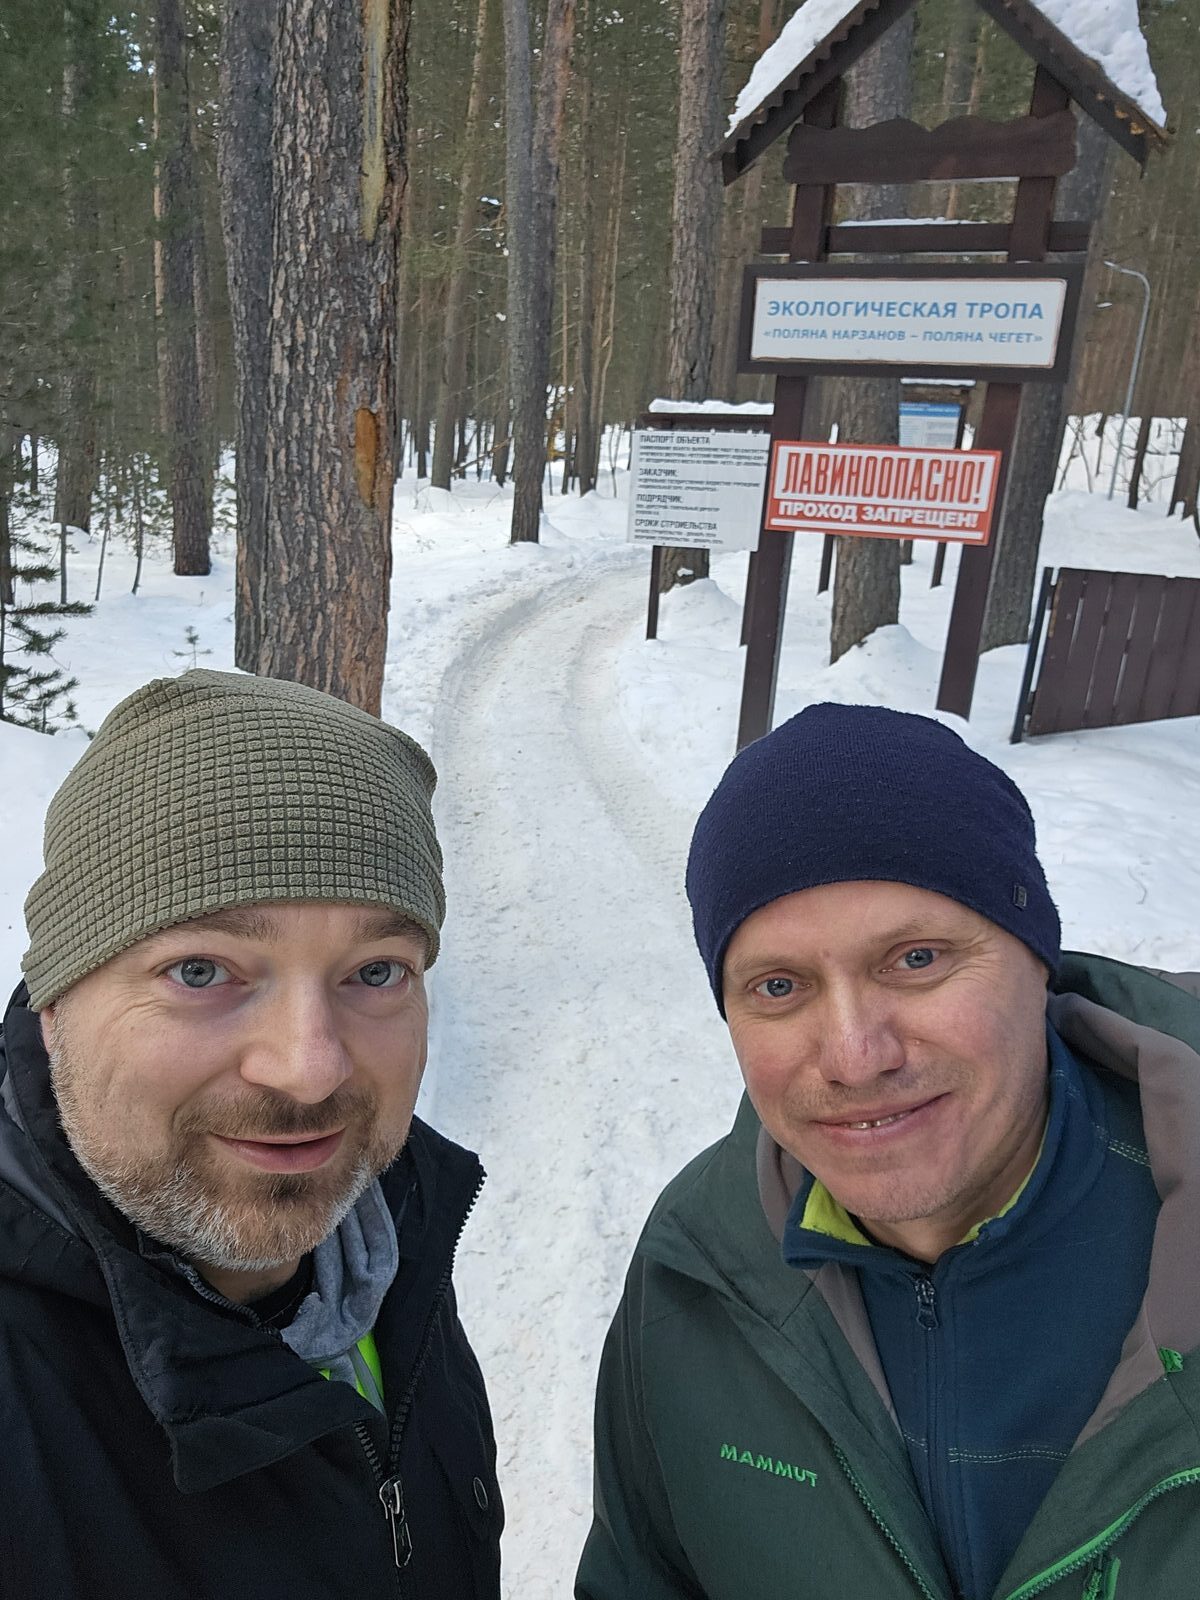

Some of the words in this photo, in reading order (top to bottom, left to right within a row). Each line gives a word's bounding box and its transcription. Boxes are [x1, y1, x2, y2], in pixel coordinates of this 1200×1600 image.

[766, 300, 956, 318] ЭКОЛОГИЧЕСКАЯ
[965, 302, 1044, 319] ТРОПА
[763, 328, 828, 341] «ПОЛЯНА
[832, 329, 906, 342] НАРЗАНОВ
[923, 331, 983, 343] ПОЛЯНА
[989, 332, 1043, 344] ЧЕГЕТ»
[639, 434, 674, 444] ПАСПОРТ
[782, 452, 986, 504] ЛАВИНООПАСНО!
[634, 518, 659, 528] СРОКИ
[779, 501, 857, 521] ПРОХОД
[861, 505, 979, 528] ЗАПРЕЩЕН!
[720, 1444, 818, 1487] MAMMUT
